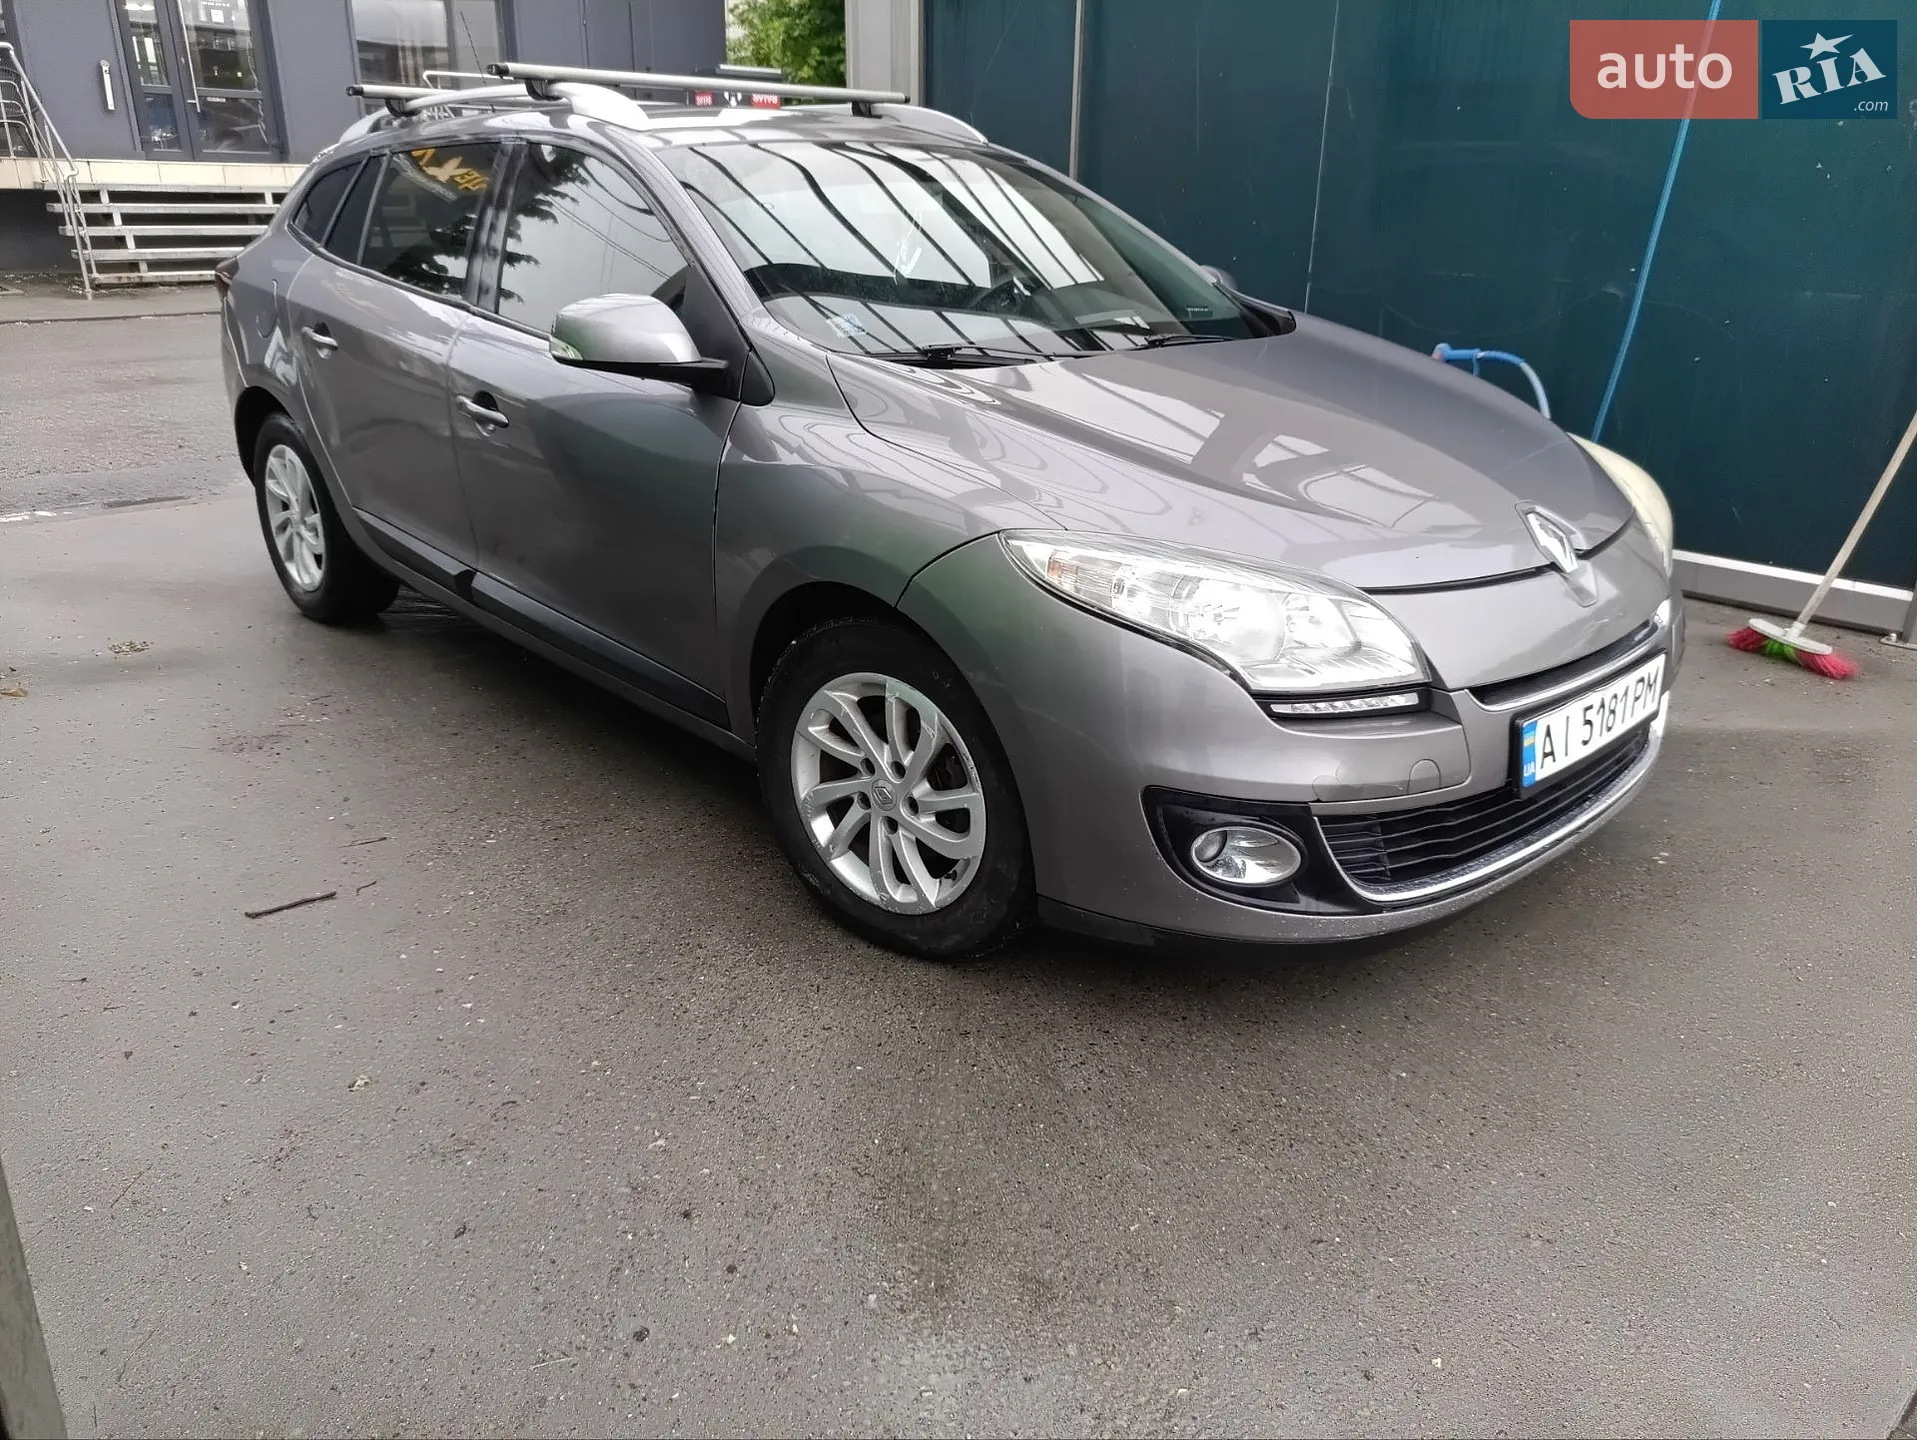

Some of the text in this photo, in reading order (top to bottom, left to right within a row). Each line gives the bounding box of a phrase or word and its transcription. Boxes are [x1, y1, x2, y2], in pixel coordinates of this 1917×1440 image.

[1540, 666, 1660, 770] AI 5181 PM
